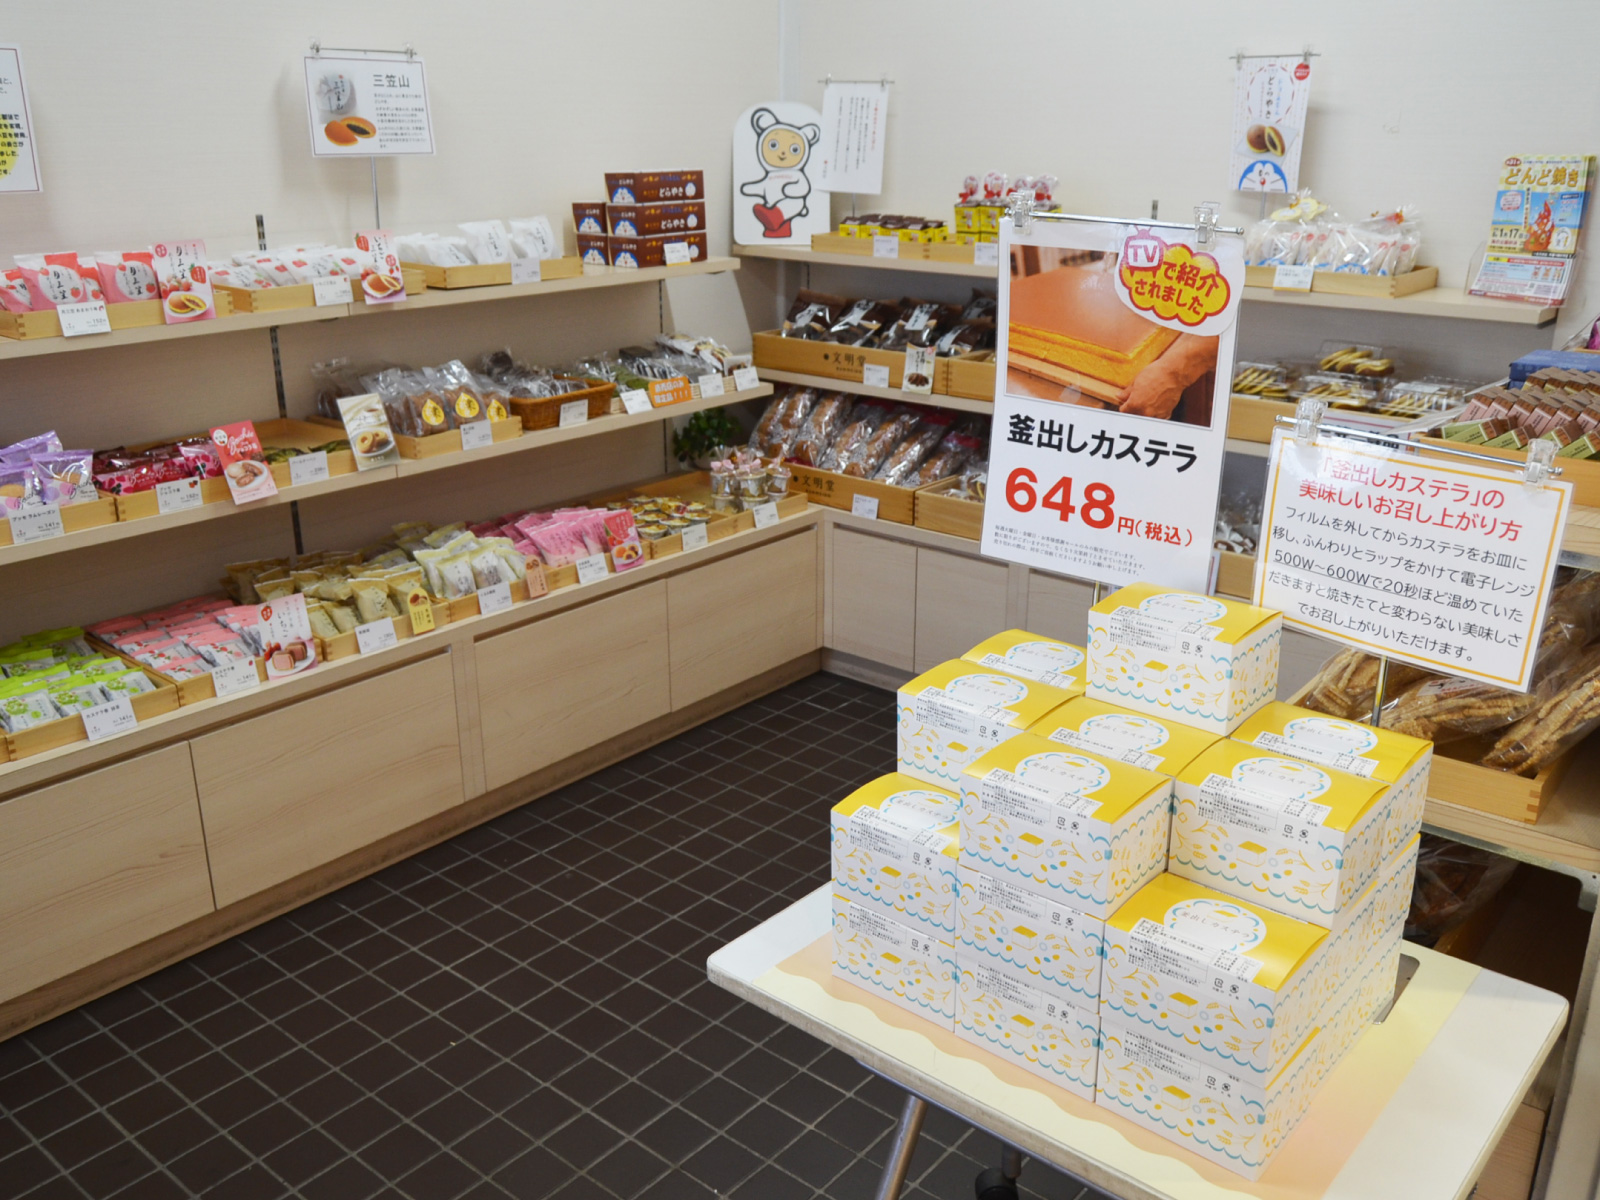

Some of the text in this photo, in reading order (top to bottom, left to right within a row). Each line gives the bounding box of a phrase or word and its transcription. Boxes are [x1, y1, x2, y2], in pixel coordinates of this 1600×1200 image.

[373, 74, 410, 88] 三笠山
[1504, 166, 1579, 188] どんど焼き
[1129, 243, 1219, 298] TV で紹介
[1134, 277, 1204, 316] されました
[1007, 413, 1197, 473] 釜出しカステラ
[803, 474, 834, 492] 文明堂
[1299, 478, 1523, 542] 美味しいお召し上がり方
[1322, 456, 1505, 510] 「釜出しカステラ」の
[1272, 525, 1536, 599] 移し、ふんわりとラップをかけて電子レンジ
[1285, 507, 1528, 572] フィルムを外してからカステラをお皿に
[1268, 570, 1523, 648] だきますと焼きたてと変わらない美味しさ
[1298, 601, 1473, 662] でお召し上がりいただけます。
[1181, 910, 1250, 939] 釜出しカステラ
